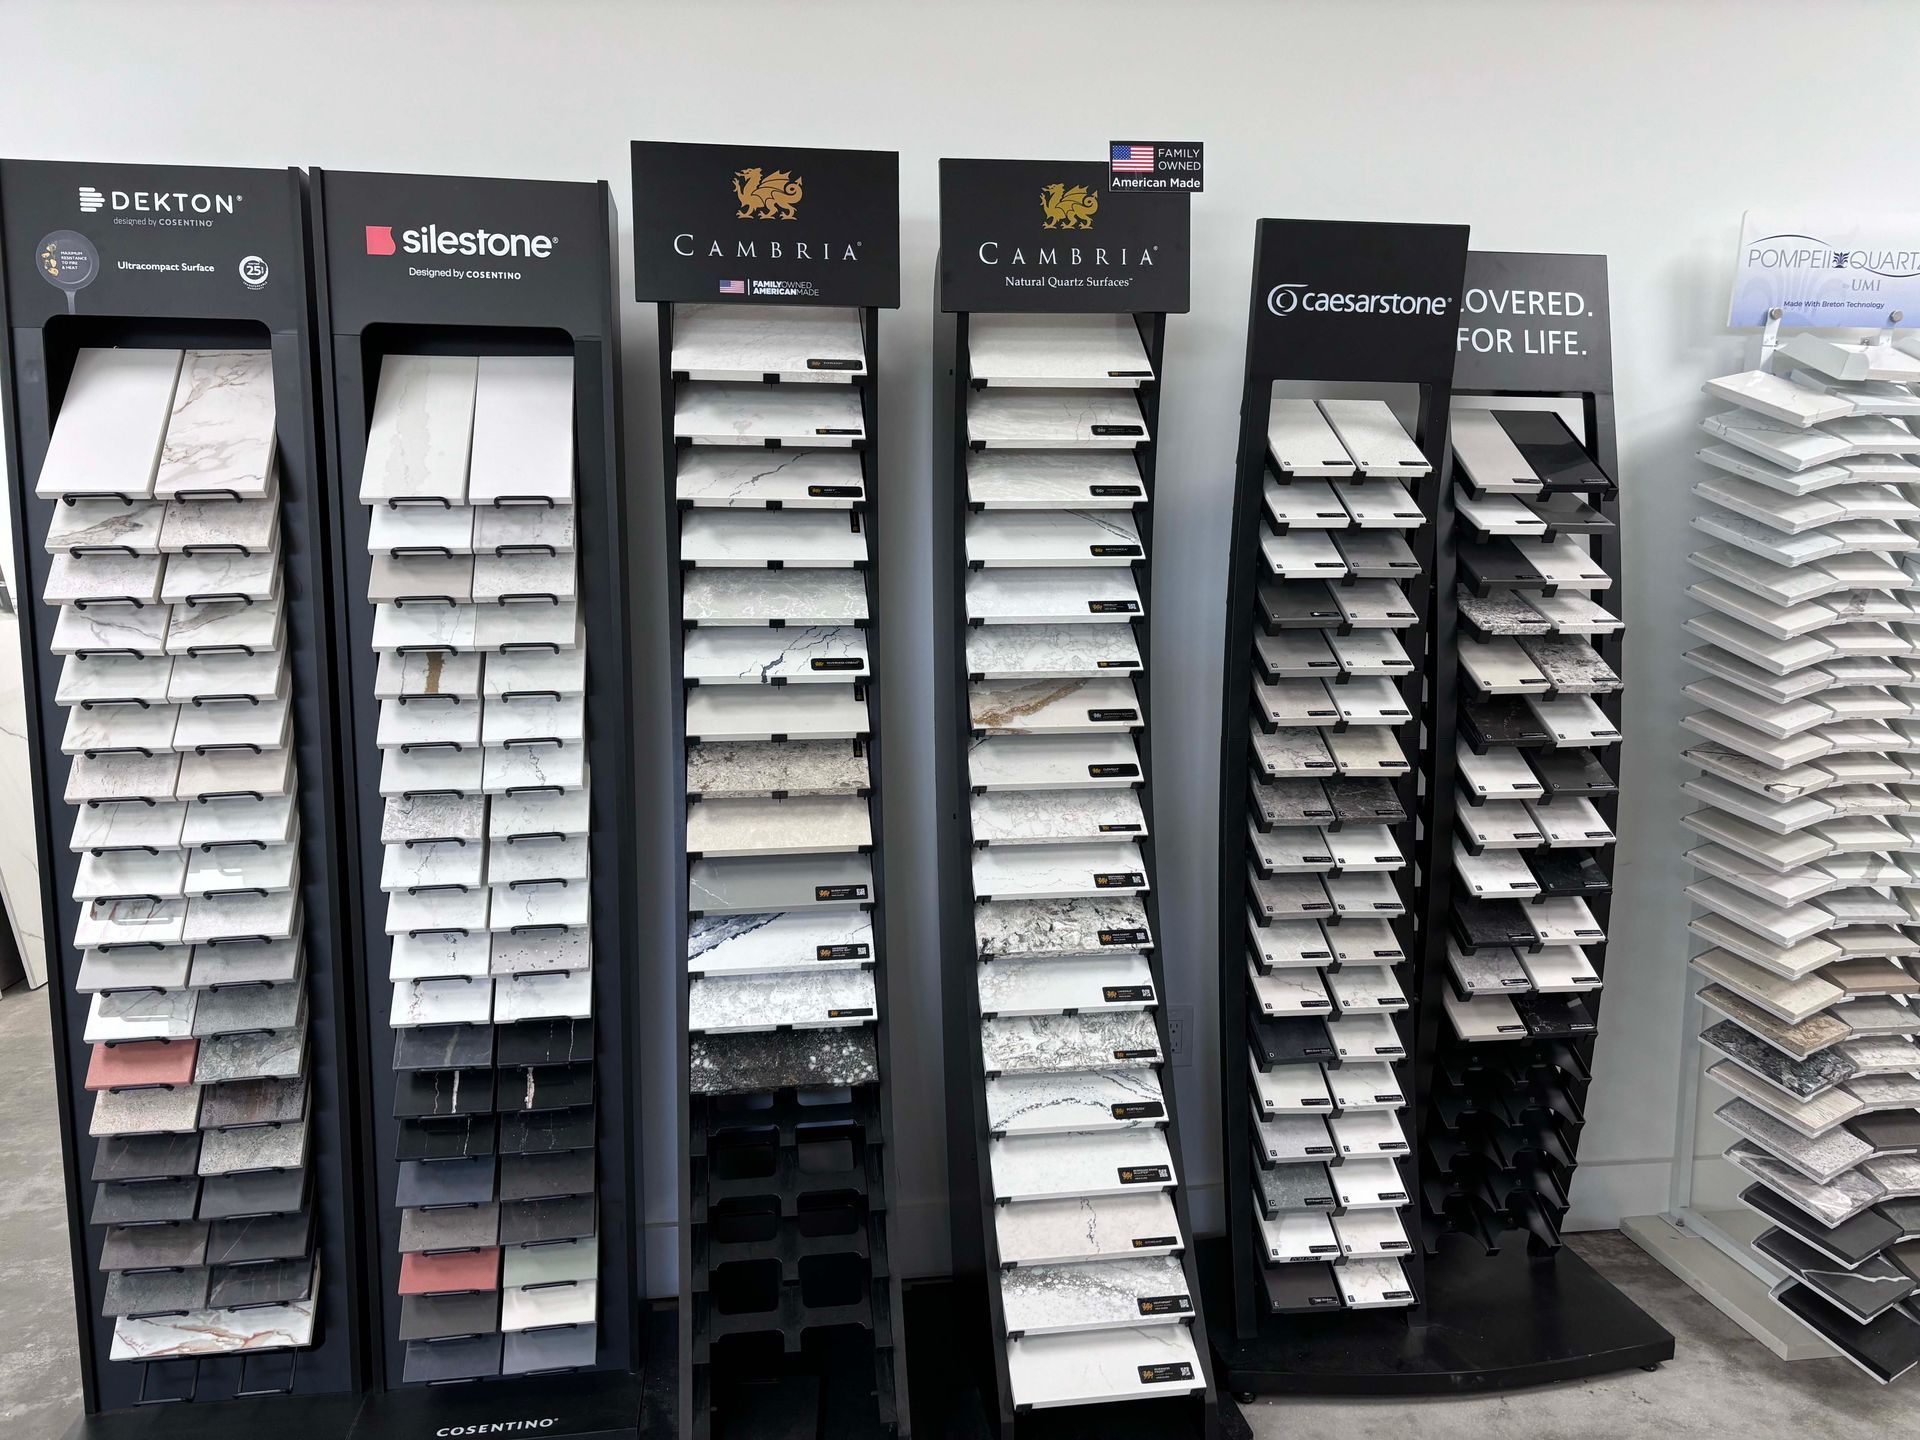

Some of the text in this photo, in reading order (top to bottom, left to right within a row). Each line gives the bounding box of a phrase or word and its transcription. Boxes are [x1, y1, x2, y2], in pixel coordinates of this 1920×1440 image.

[1158, 148, 1200, 159] FAMILY
[1158, 161, 1201, 171] OWNED
[1112, 177, 1200, 189] American Made
[113, 217, 214, 227] designed by COSENTINO
[402, 223, 553, 258] silestone
[1748, 249, 1920, 270] POMPEII QUART
[117, 261, 215, 273] Ultracompact Surface
[409, 267, 521, 280] Designed by COSENTINO
[1005, 276, 1045, 287] Natural
[1048, 277, 1084, 289] Quartz
[1851, 279, 1881, 292] UMI
[1301, 291, 1447, 316] caesarstone
[1460, 288, 1594, 317] OVERED.
[1783, 300, 1803, 308] Made
[1846, 301, 1885, 309] Technology
[1457, 327, 1588, 356] FOR LIFE.
[436, 1418, 554, 1437] COSENTINO
